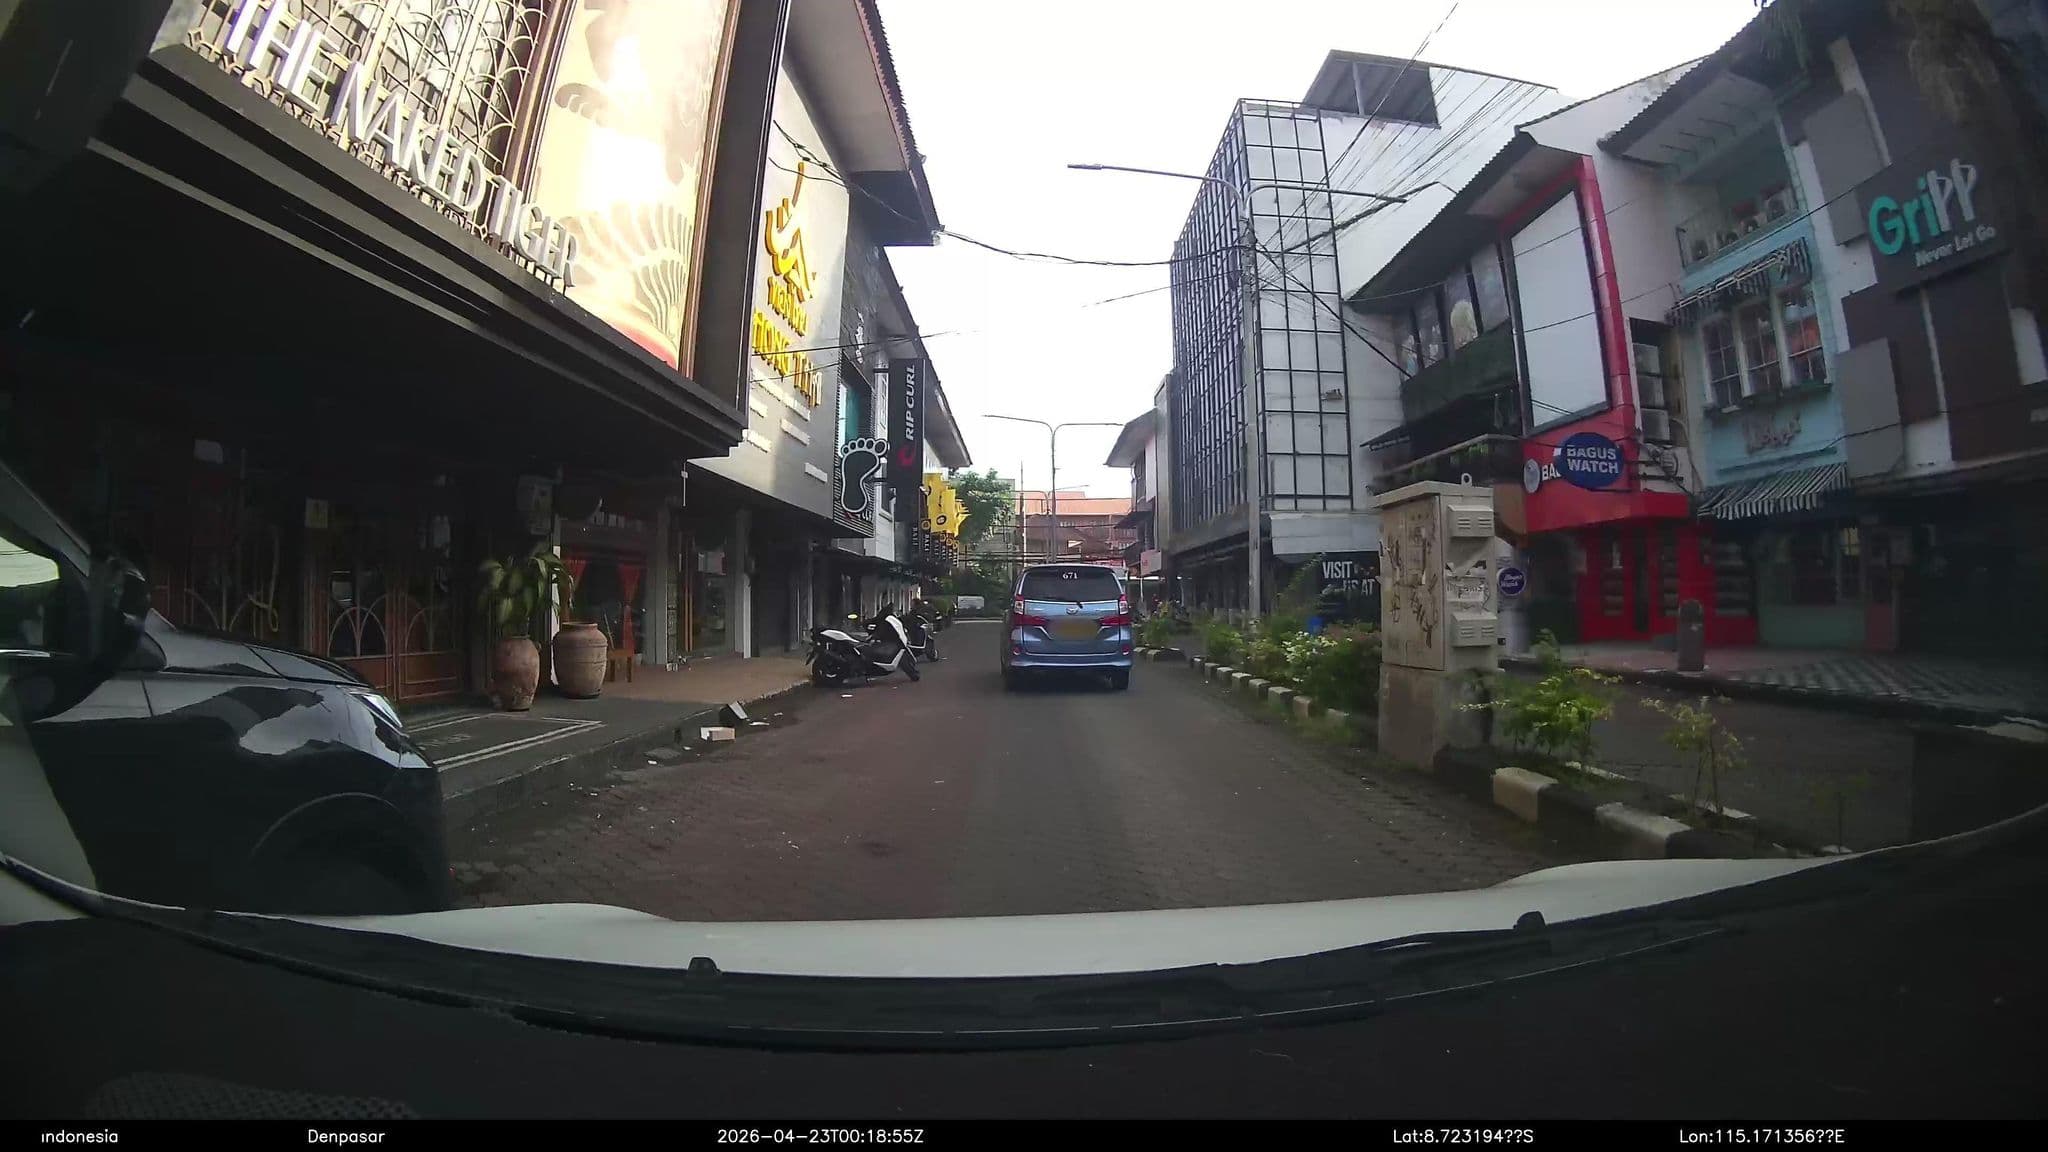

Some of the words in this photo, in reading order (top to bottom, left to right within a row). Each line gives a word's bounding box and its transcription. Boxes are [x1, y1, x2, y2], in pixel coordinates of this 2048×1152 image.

[331, 61, 486, 214] NAKED
[489, 174, 580, 288] TIGER
[905, 364, 915, 409] CURL
[905, 410, 915, 441] RIP
[1566, 445, 1617, 461] BAGUS
[1566, 459, 1620, 475] WATCH
[1062, 572, 1078, 580] 671
[1322, 561, 1353, 579] VISIT
[1361, 578, 1375, 597] AT
